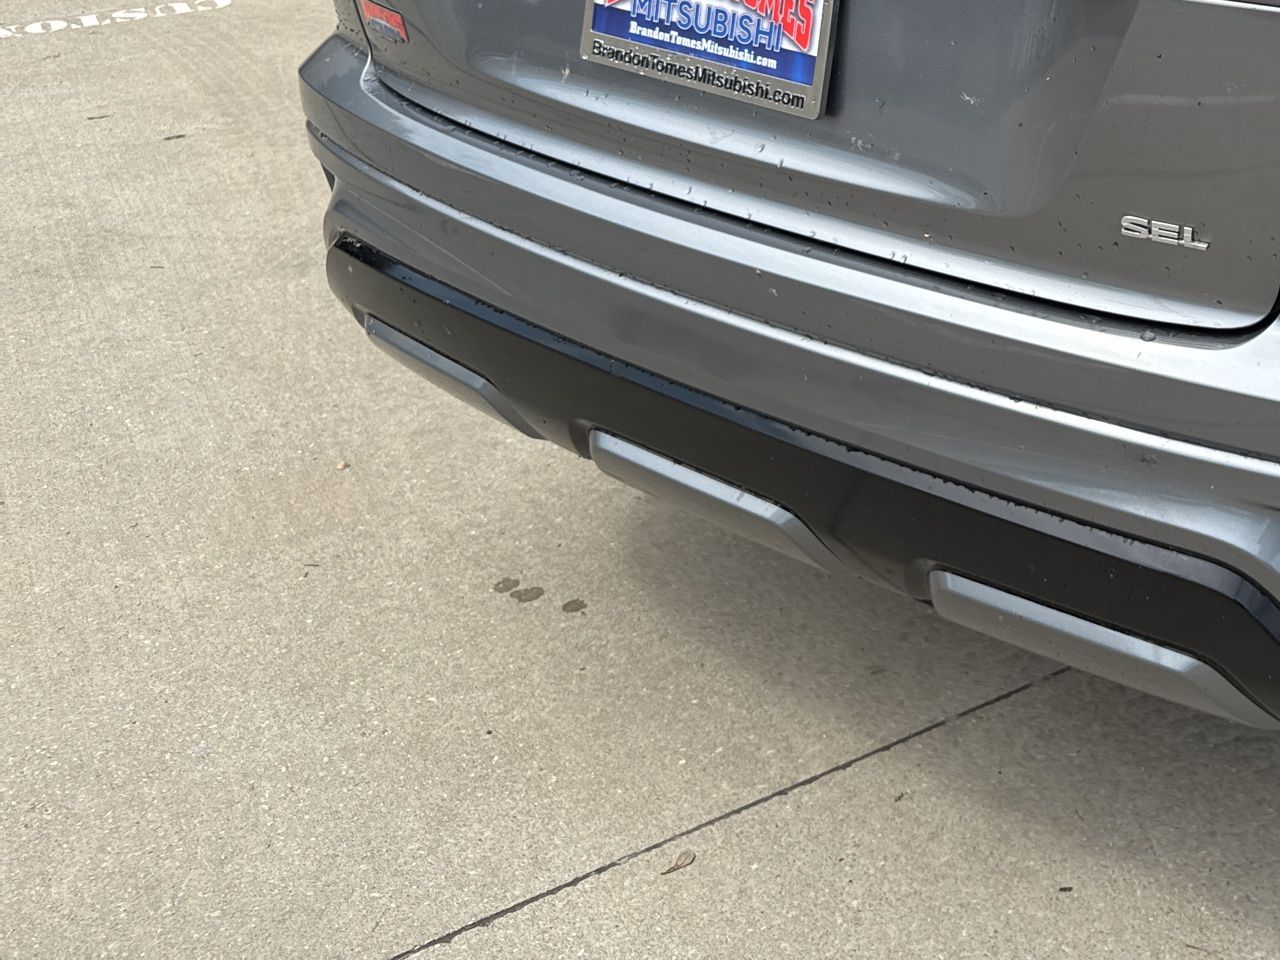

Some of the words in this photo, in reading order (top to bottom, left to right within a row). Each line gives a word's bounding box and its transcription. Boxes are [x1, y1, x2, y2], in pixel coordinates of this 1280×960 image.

[629, 21, 777, 69] BrandonTomesMitsubishi.com
[592, 40, 805, 109] BrandonTomesMitsubishi.com
[1121, 215, 1210, 250] SEL
